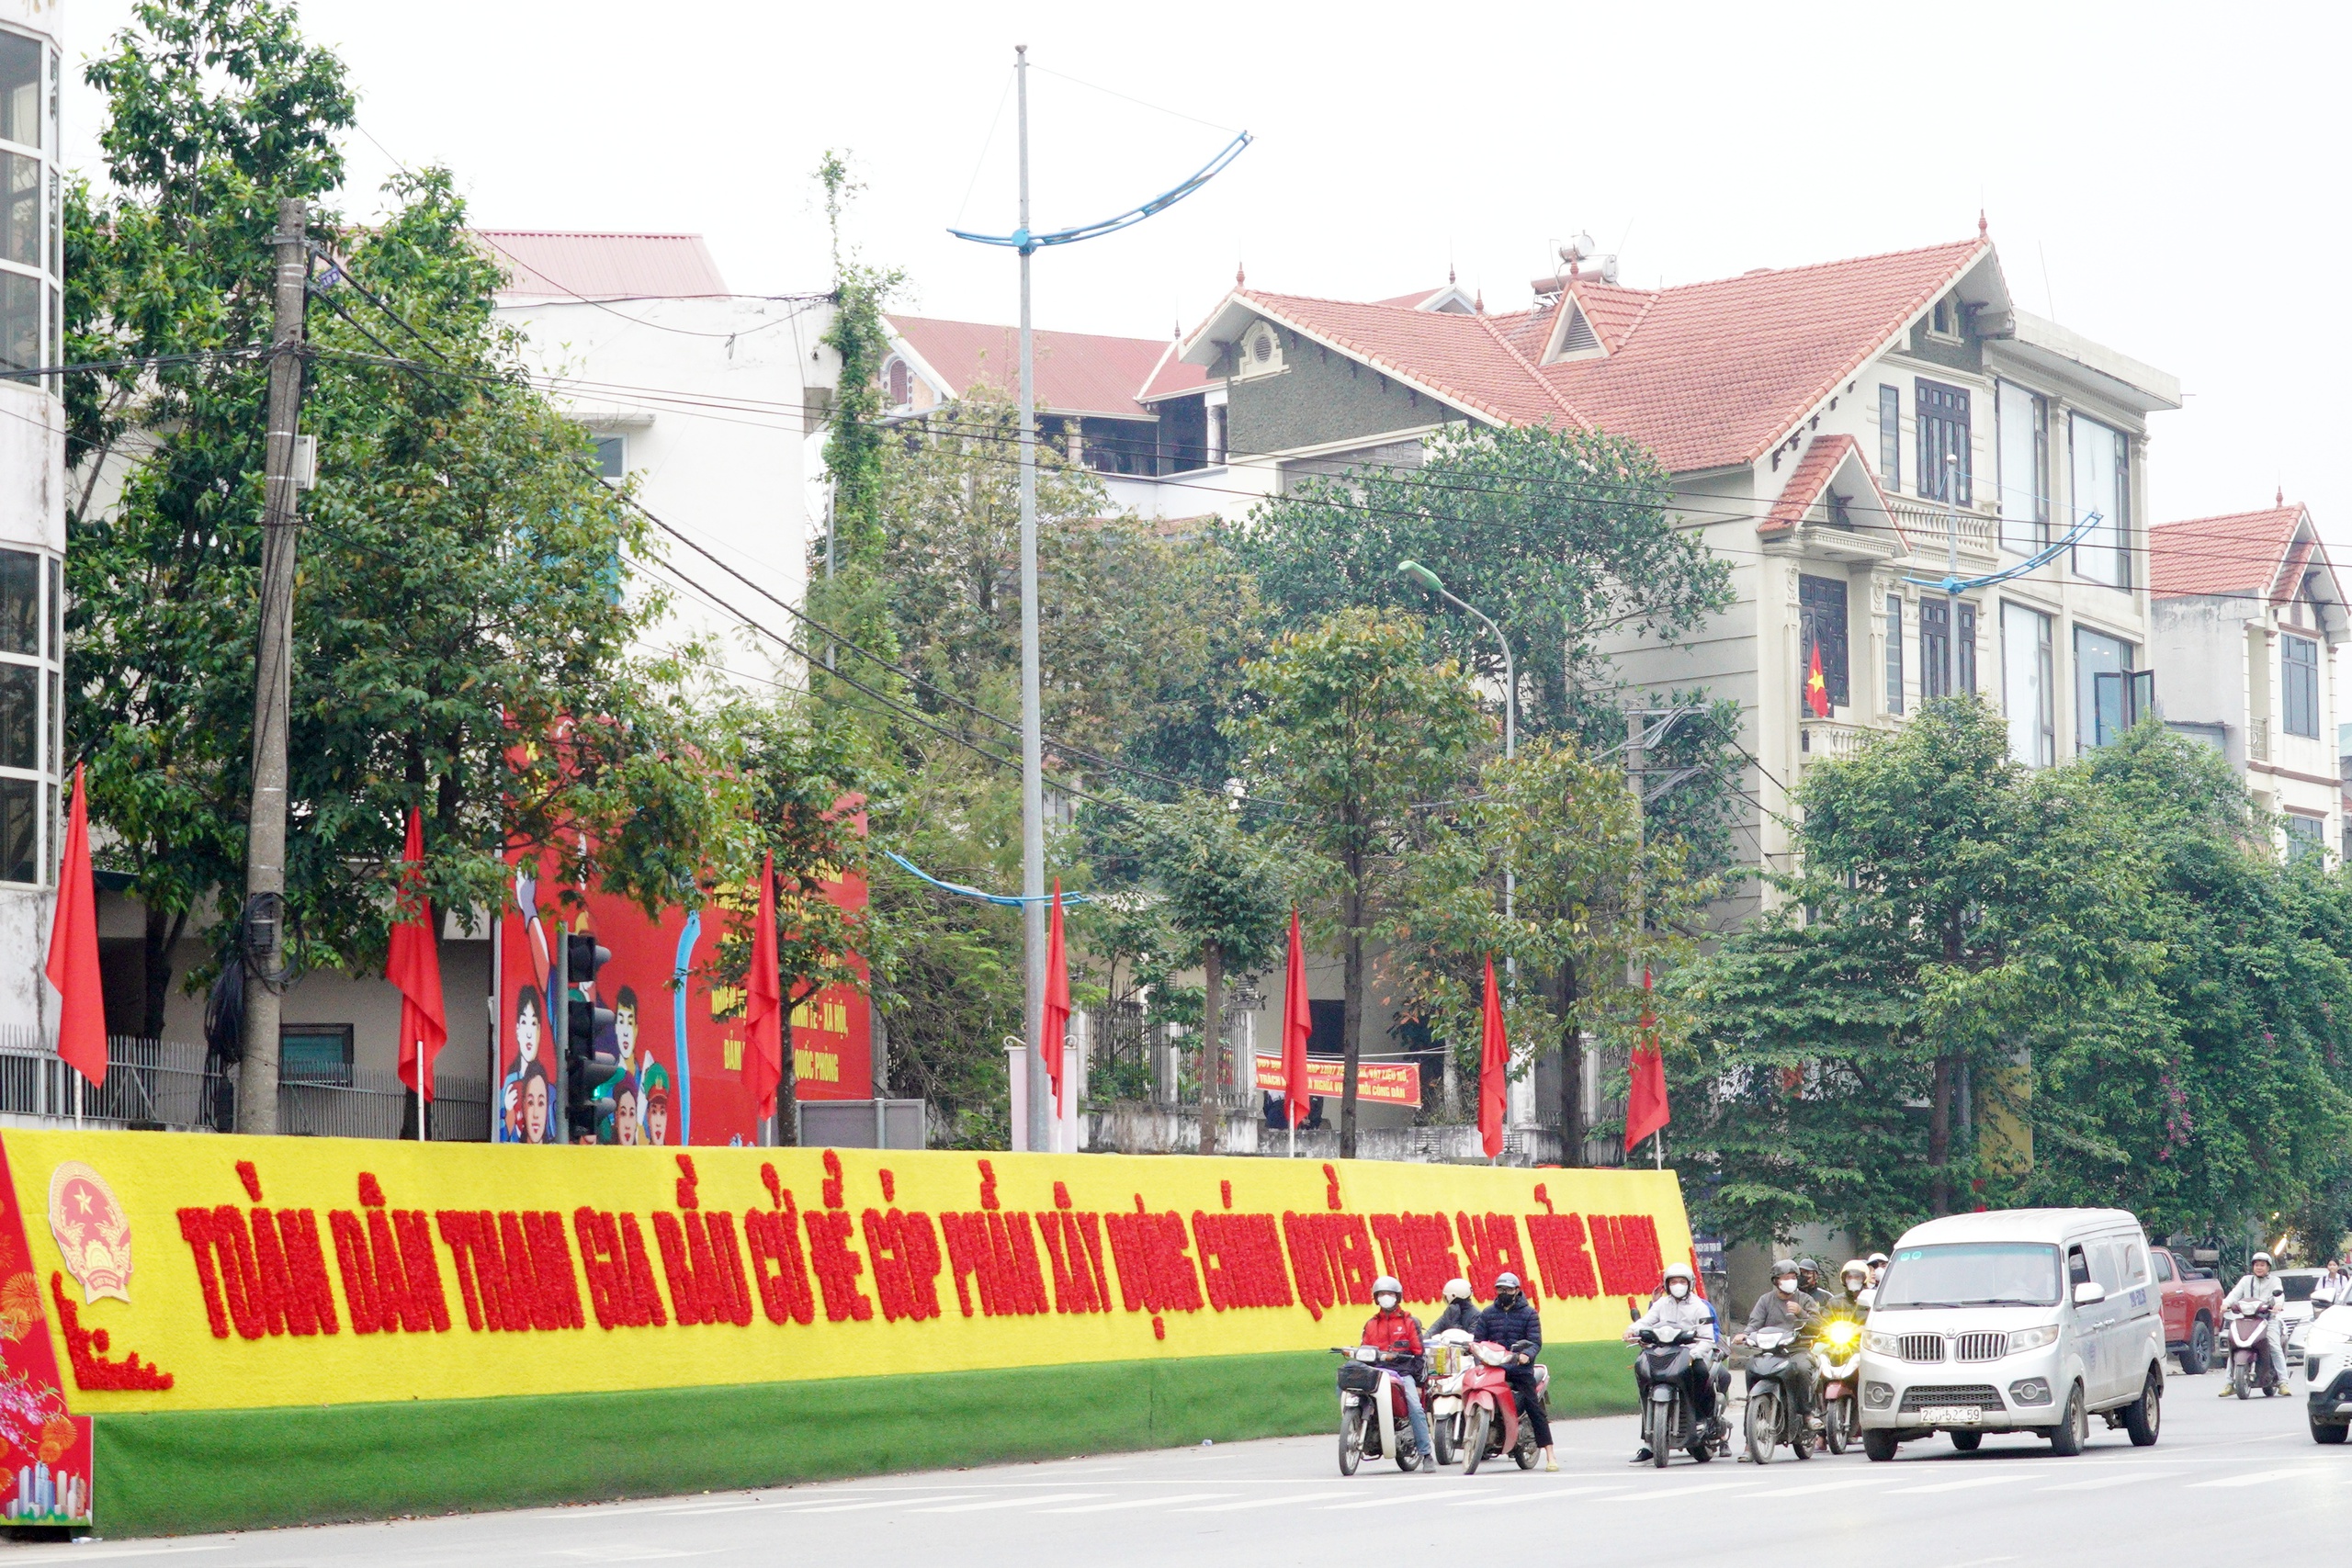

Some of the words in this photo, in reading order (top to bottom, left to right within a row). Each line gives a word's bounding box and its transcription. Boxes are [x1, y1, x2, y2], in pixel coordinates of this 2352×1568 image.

[823, 998, 833, 1032] XÃ
[795, 1039, 814, 1082] QUỐC
[815, 1045, 840, 1083] PHÒNG
[1258, 1073, 1282, 1087] TRÁCH
[176, 1160, 340, 1340] TOÀN
[328, 1171, 451, 1335] DÂN
[435, 1210, 586, 1332] THAM
[574, 1205, 668, 1331] GIA
[651, 1153, 753, 1327] BẦU
[744, 1162, 815, 1326] CỬ
[803, 1148, 874, 1323] ĐỂ
[862, 1168, 943, 1324] GÓP
[939, 1158, 1050, 1318] PHẦN
[1035, 1181, 1113, 1314] XÂY
[1104, 1193, 1205, 1340] DỰNG
[1192, 1179, 1295, 1314] CHÍNH
[1283, 1163, 1379, 1322] QUYỀN
